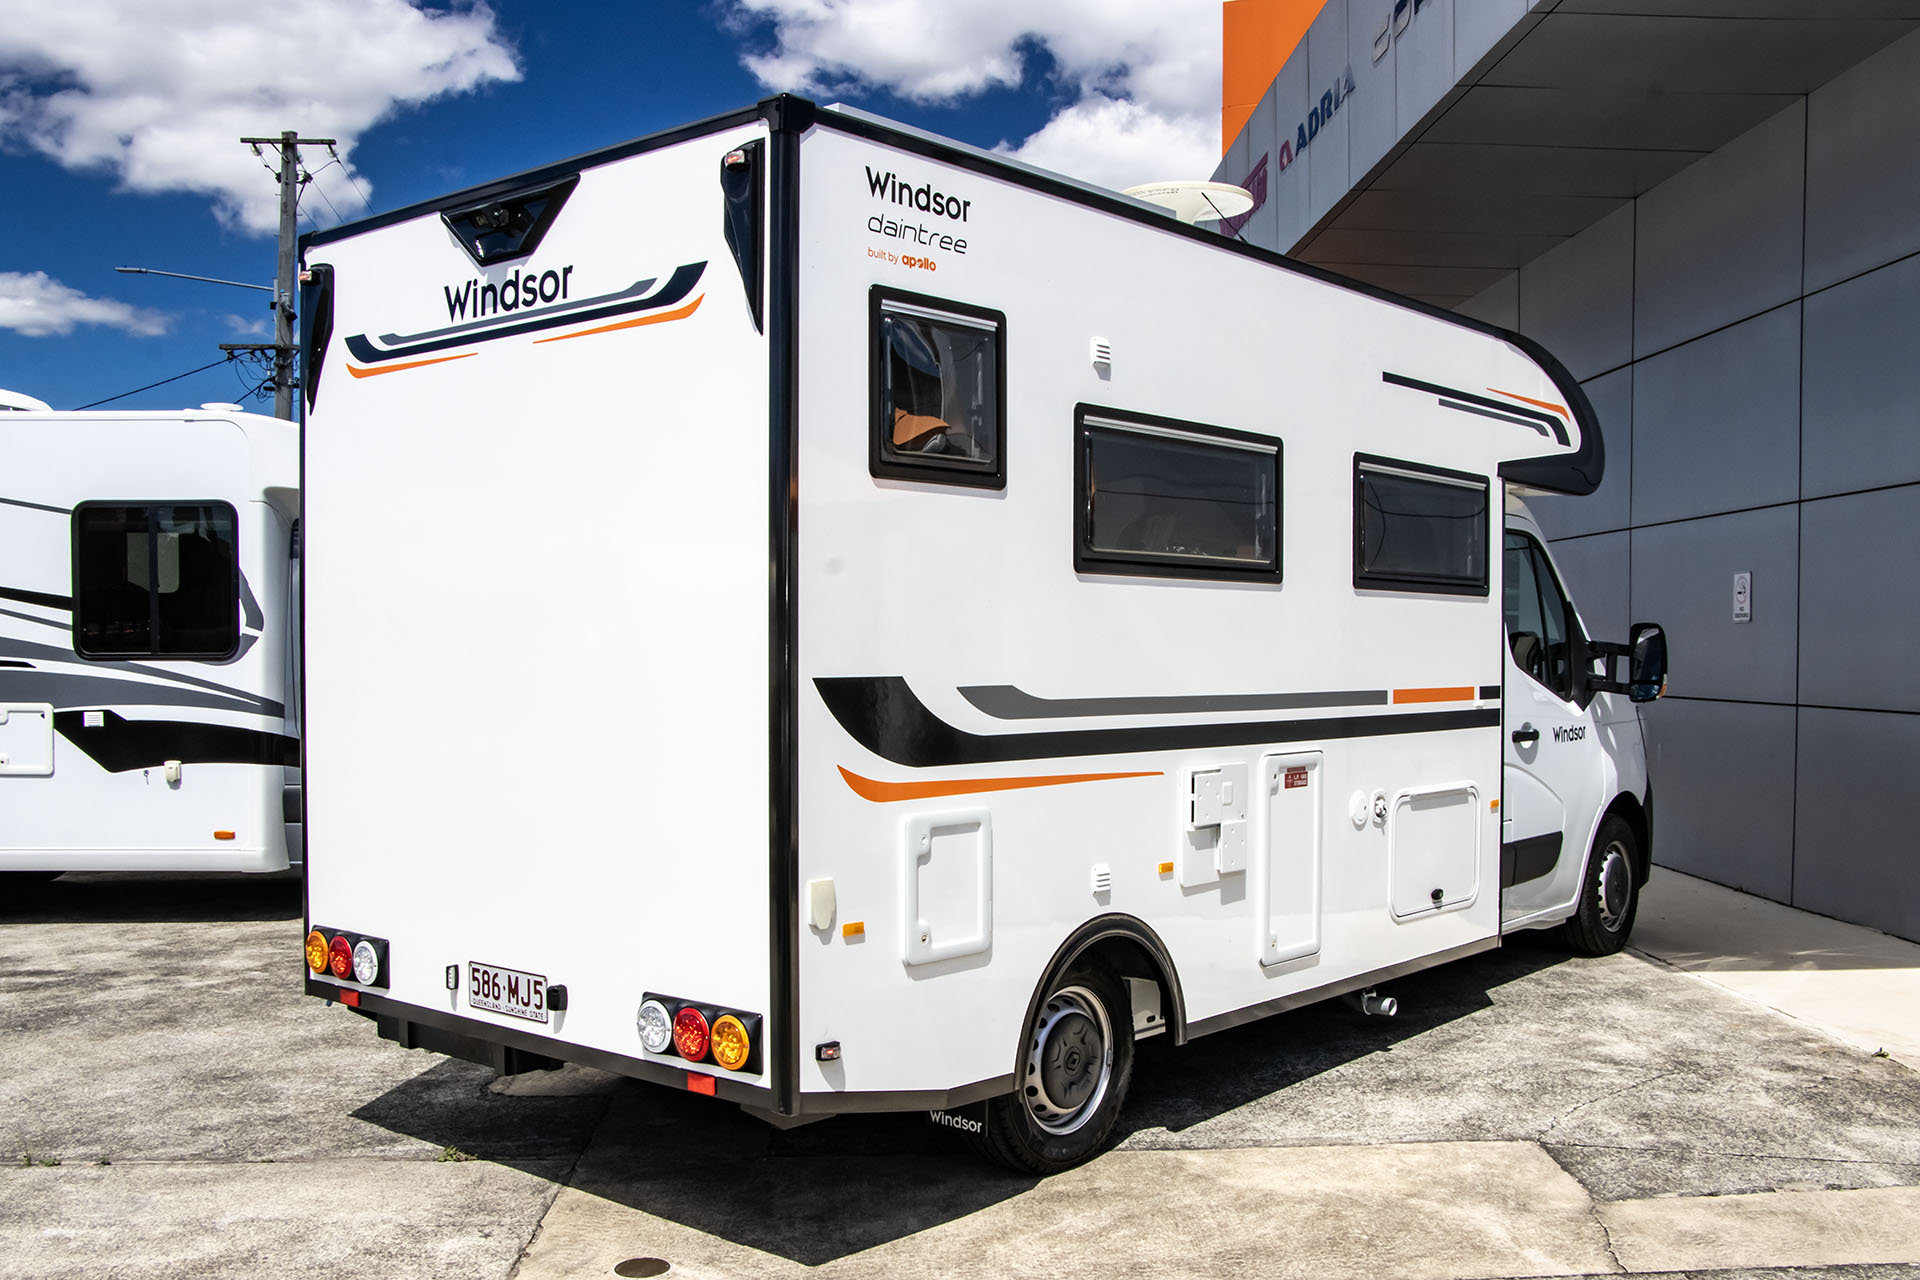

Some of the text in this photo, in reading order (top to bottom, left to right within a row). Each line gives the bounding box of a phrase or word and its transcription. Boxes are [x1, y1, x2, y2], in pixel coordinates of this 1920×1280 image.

[1296, 63, 1356, 157] ADRIA
[865, 165, 971, 222] Windsor
[867, 213, 968, 254] daintree
[867, 246, 937, 271] built by apollo
[444, 265, 574, 323] Windsor
[1552, 725, 1587, 743] Windsor
[929, 1110, 983, 1134] Windsor
